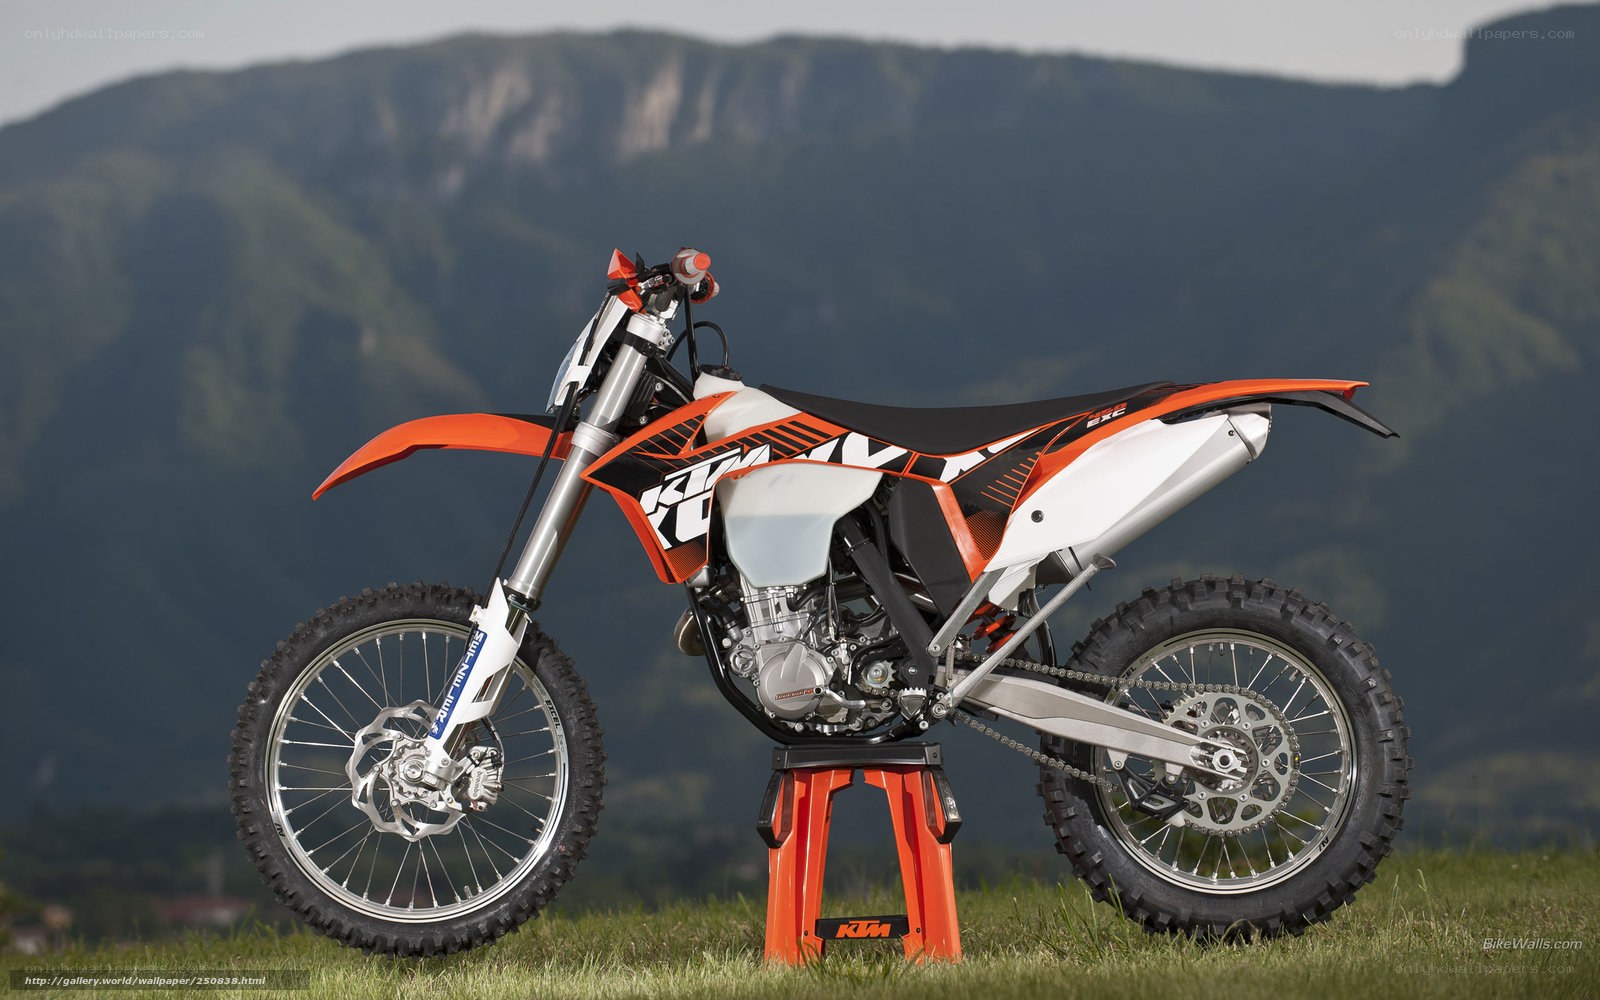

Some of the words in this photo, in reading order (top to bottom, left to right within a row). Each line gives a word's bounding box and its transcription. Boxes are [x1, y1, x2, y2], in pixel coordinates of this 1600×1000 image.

[1087, 407, 1126, 428] EXC
[640, 443, 770, 515] KTM
[436, 629, 484, 724] METZELER
[545, 699, 561, 729] EXCEL
[835, 920, 891, 938] KTM
